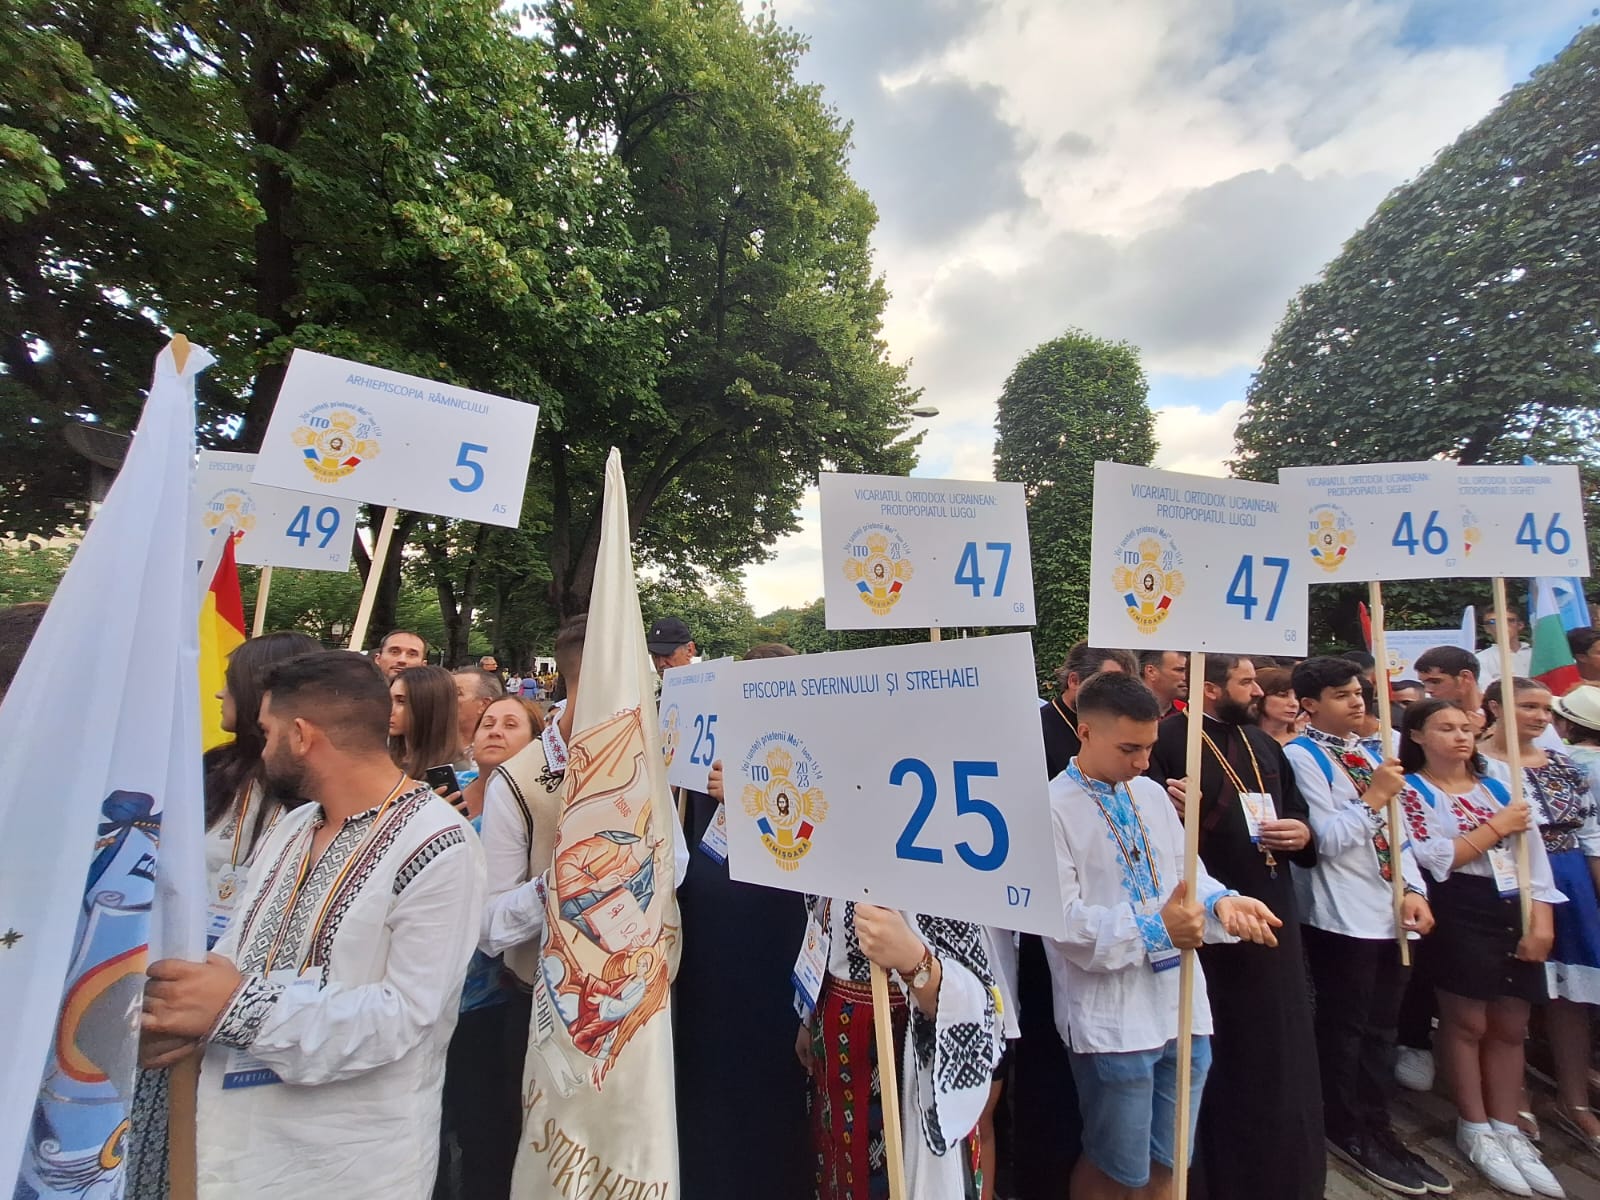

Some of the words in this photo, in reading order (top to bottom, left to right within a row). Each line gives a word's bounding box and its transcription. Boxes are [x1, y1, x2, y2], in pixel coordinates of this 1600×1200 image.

[346, 374, 424, 400] ARHIEPISCOPIA
[428, 392, 489, 416] RÂMNICULUI
[310, 416, 330, 429] ITO
[449, 442, 488, 493] 5
[855, 489, 902, 502] VICARIATUL
[906, 490, 946, 504] ORTODOX
[1131, 483, 1181, 503] VICARIATUL
[1184, 490, 1227, 507] ORTODOX
[492, 503, 508, 514] A5
[881, 504, 947, 518] PROTOPOPIATUL
[951, 506, 976, 519] LUGOJ
[1157, 504, 1226, 524] PROTOPOPIATUL
[1229, 511, 1256, 527] LUGOJ
[285, 505, 341, 549] 49
[1392, 510, 1449, 556] 46
[1515, 512, 1571, 555] 46
[853, 545, 869, 557] ITO
[890, 542, 900, 550] 20
[1123, 551, 1140, 564] ITO
[1163, 550, 1173, 560] 20
[954, 541, 1012, 597] 47
[1162, 561, 1173, 570] 23
[1226, 554, 1290, 622] 47
[1013, 602, 1025, 613] G8
[1284, 630, 1297, 642] G8
[743, 679, 797, 699] EPISCOPIA
[800, 674, 880, 697] SEVERINULUI
[886, 671, 899, 697] ȘI
[906, 666, 980, 691] STREHAIEI
[689, 714, 718, 767] 25
[761, 730, 786, 746] prietenii
[751, 765, 770, 782] ITO
[795, 762, 808, 775] 20
[798, 774, 810, 788] 23
[888, 757, 1010, 872] 25
[1007, 885, 1031, 908] D7
